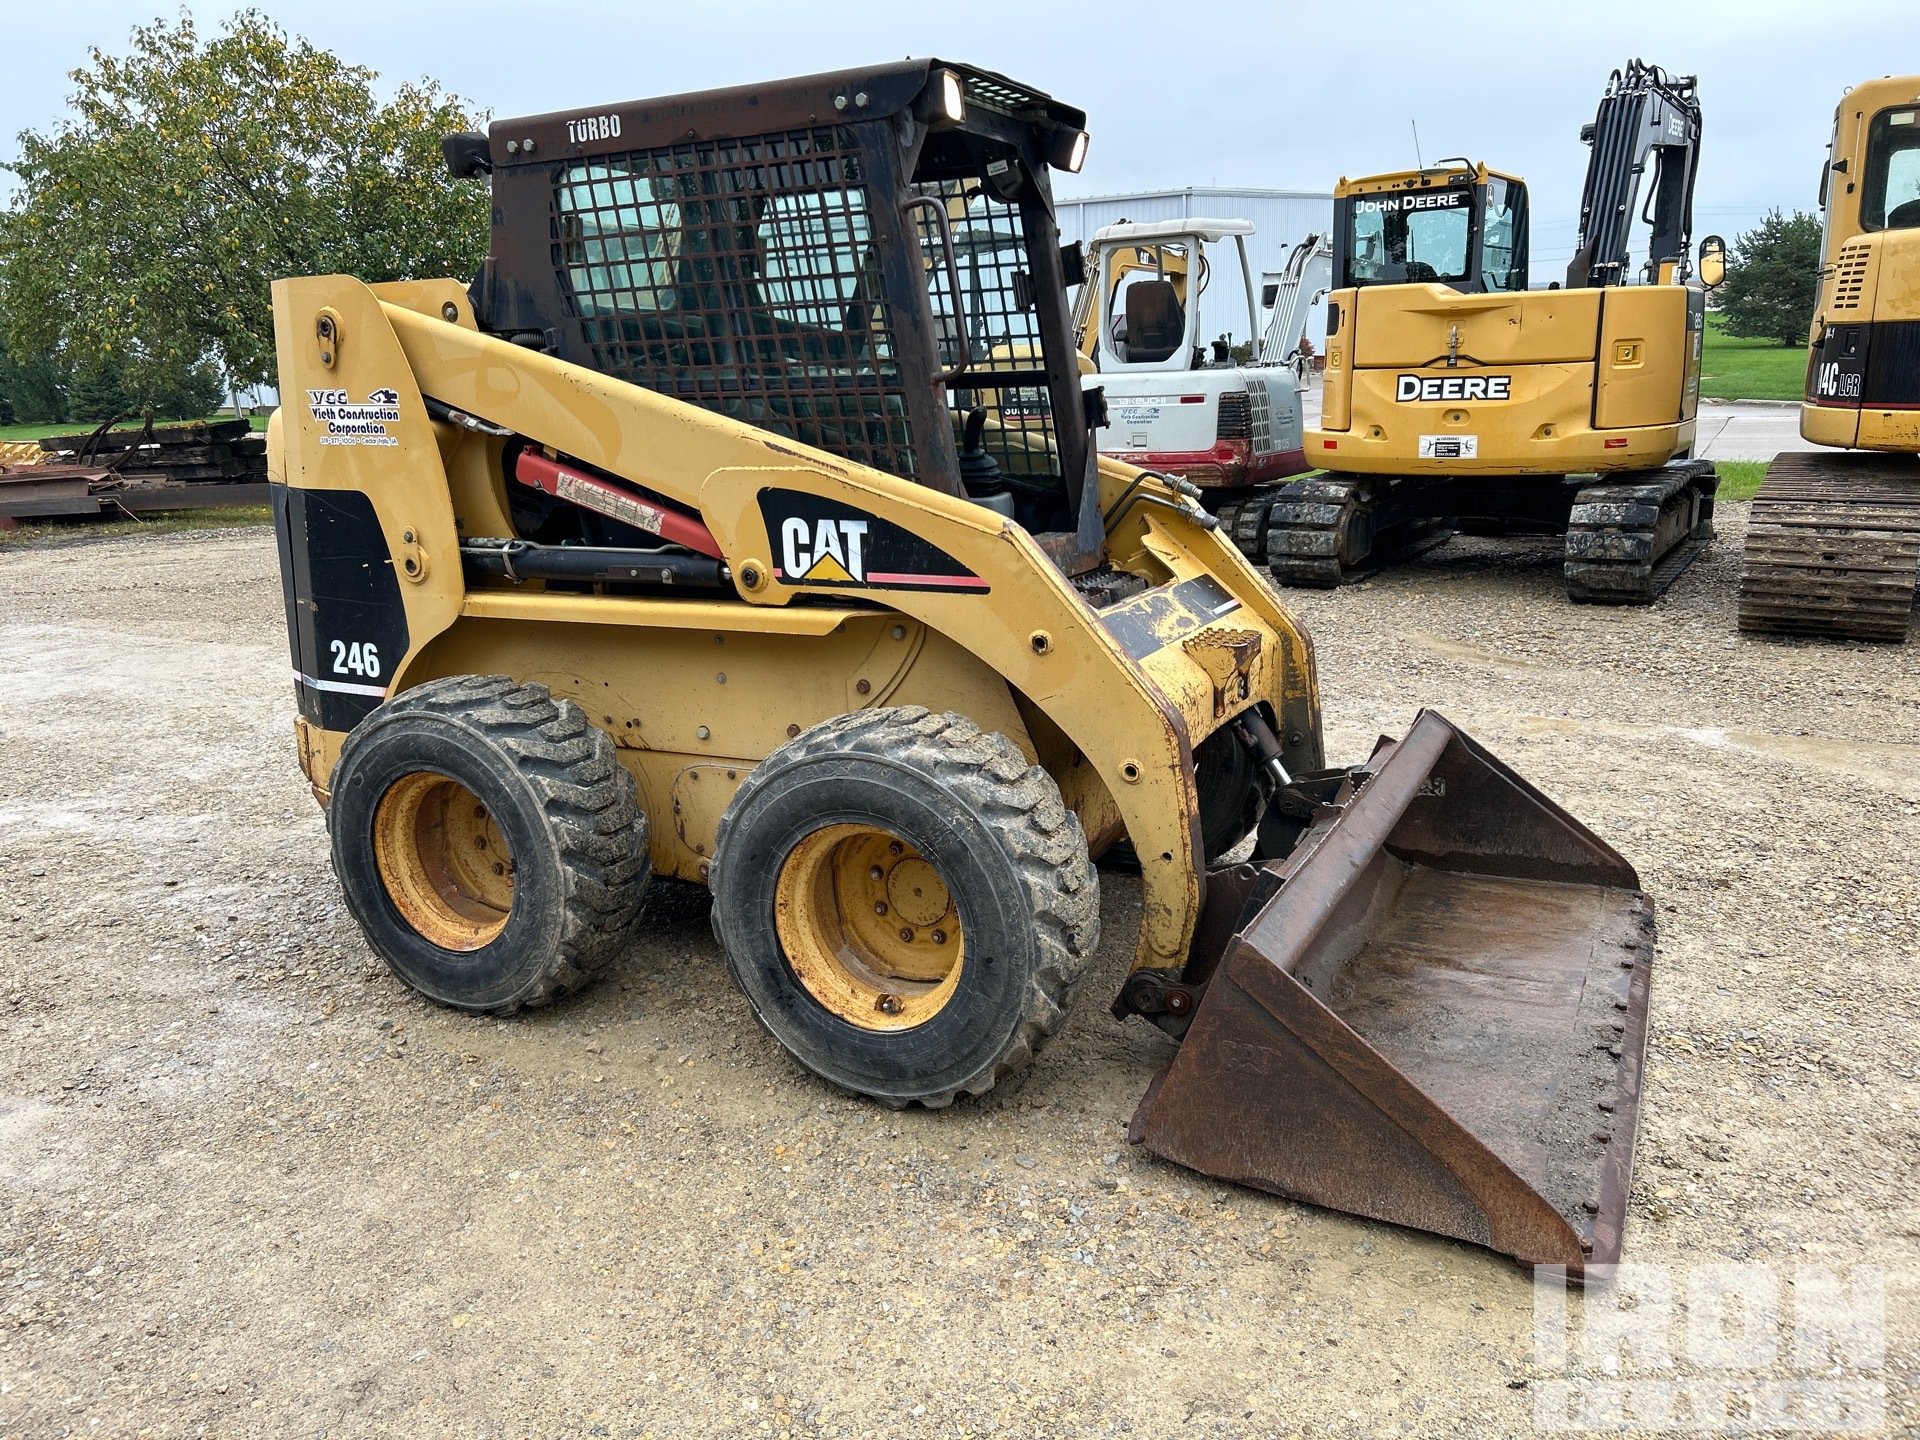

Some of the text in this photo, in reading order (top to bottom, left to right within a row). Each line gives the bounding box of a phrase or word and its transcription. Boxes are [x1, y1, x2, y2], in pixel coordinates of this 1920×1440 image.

[566, 114, 622, 143] TURBO
[1668, 112, 1684, 137] DEERE
[1355, 194, 1459, 214] JOHN DEERE
[1397, 375, 1510, 401] DEERE
[1839, 373, 1860, 396] LCR
[312, 408, 399, 420] Vieth Construction
[328, 422, 385, 436] Corporation
[782, 517, 868, 582] CAT
[330, 639, 380, 678] 246
